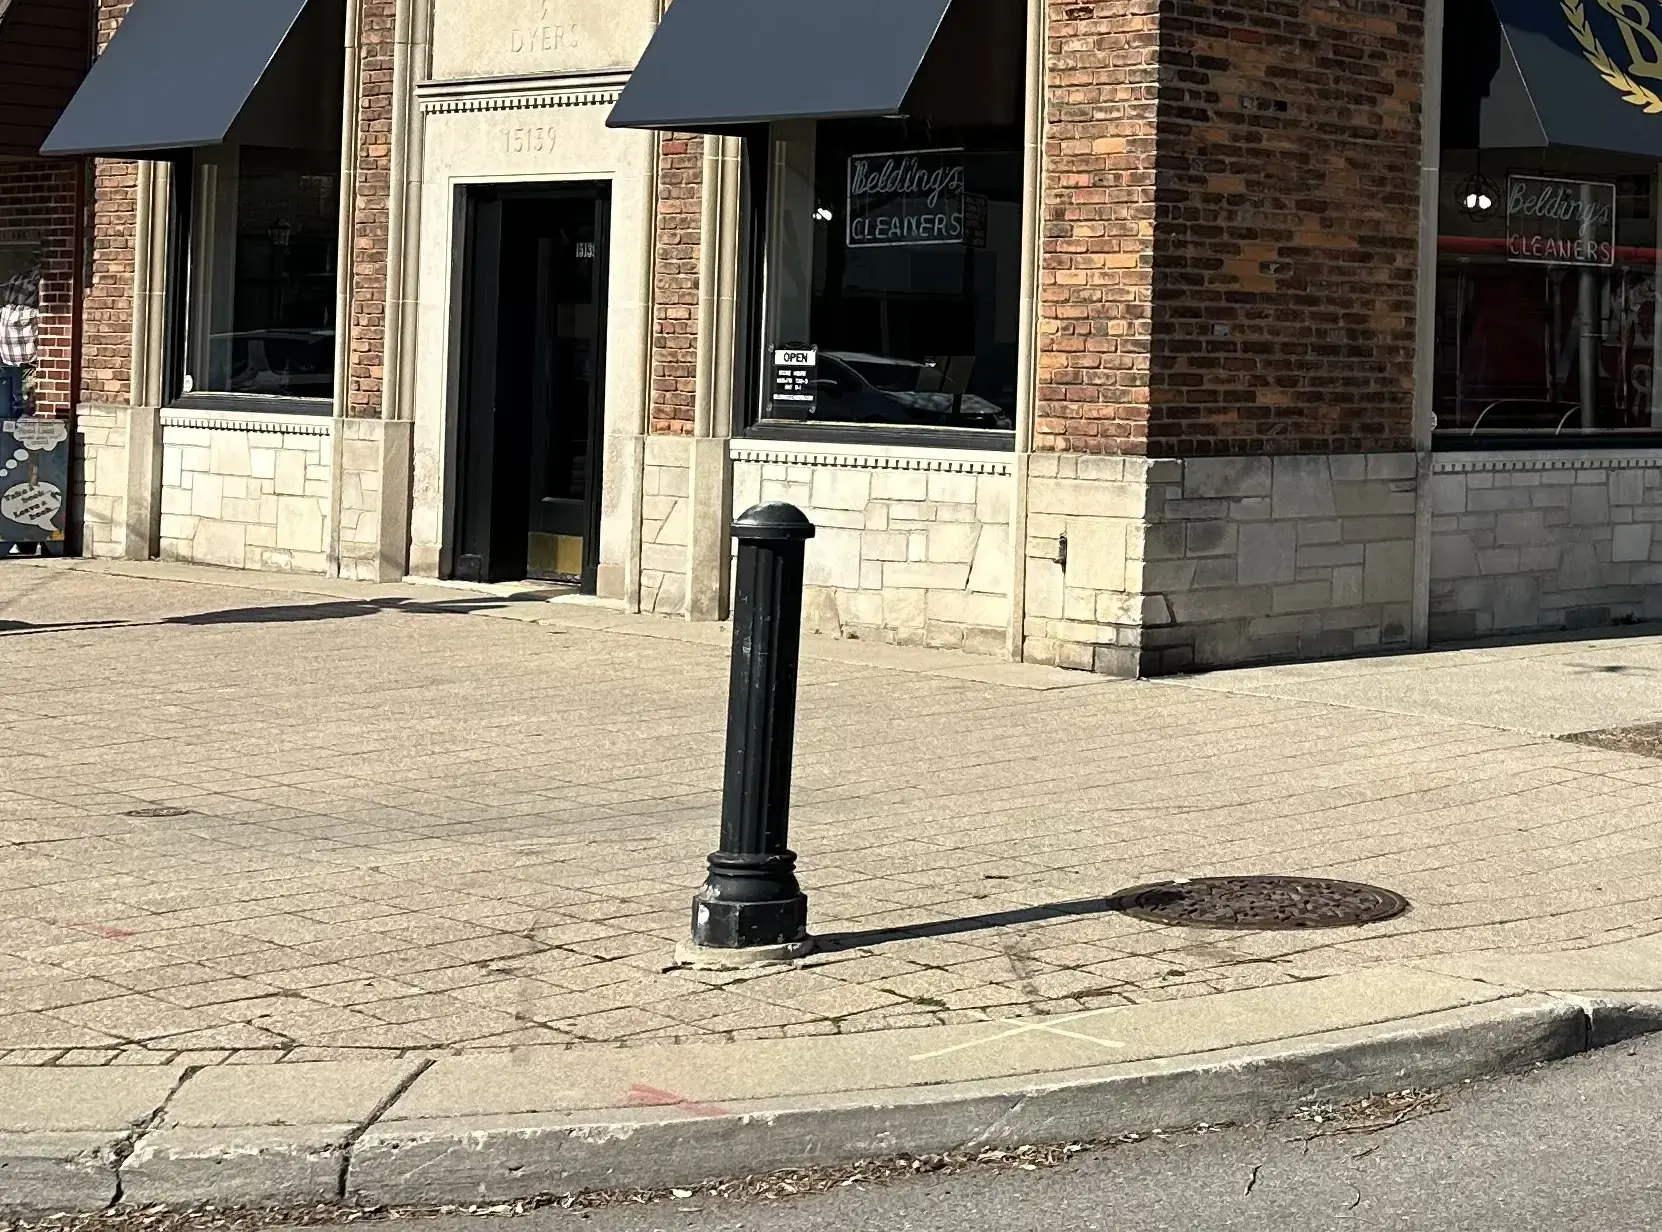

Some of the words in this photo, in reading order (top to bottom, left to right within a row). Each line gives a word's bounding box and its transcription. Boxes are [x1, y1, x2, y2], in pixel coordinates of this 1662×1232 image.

[504, 126, 557, 155] 15139
[851, 156, 964, 209] Belding's
[851, 212, 963, 240] CLEANERS
[1509, 233, 1611, 262] CLEANERS
[783, 351, 809, 364] OPEN
